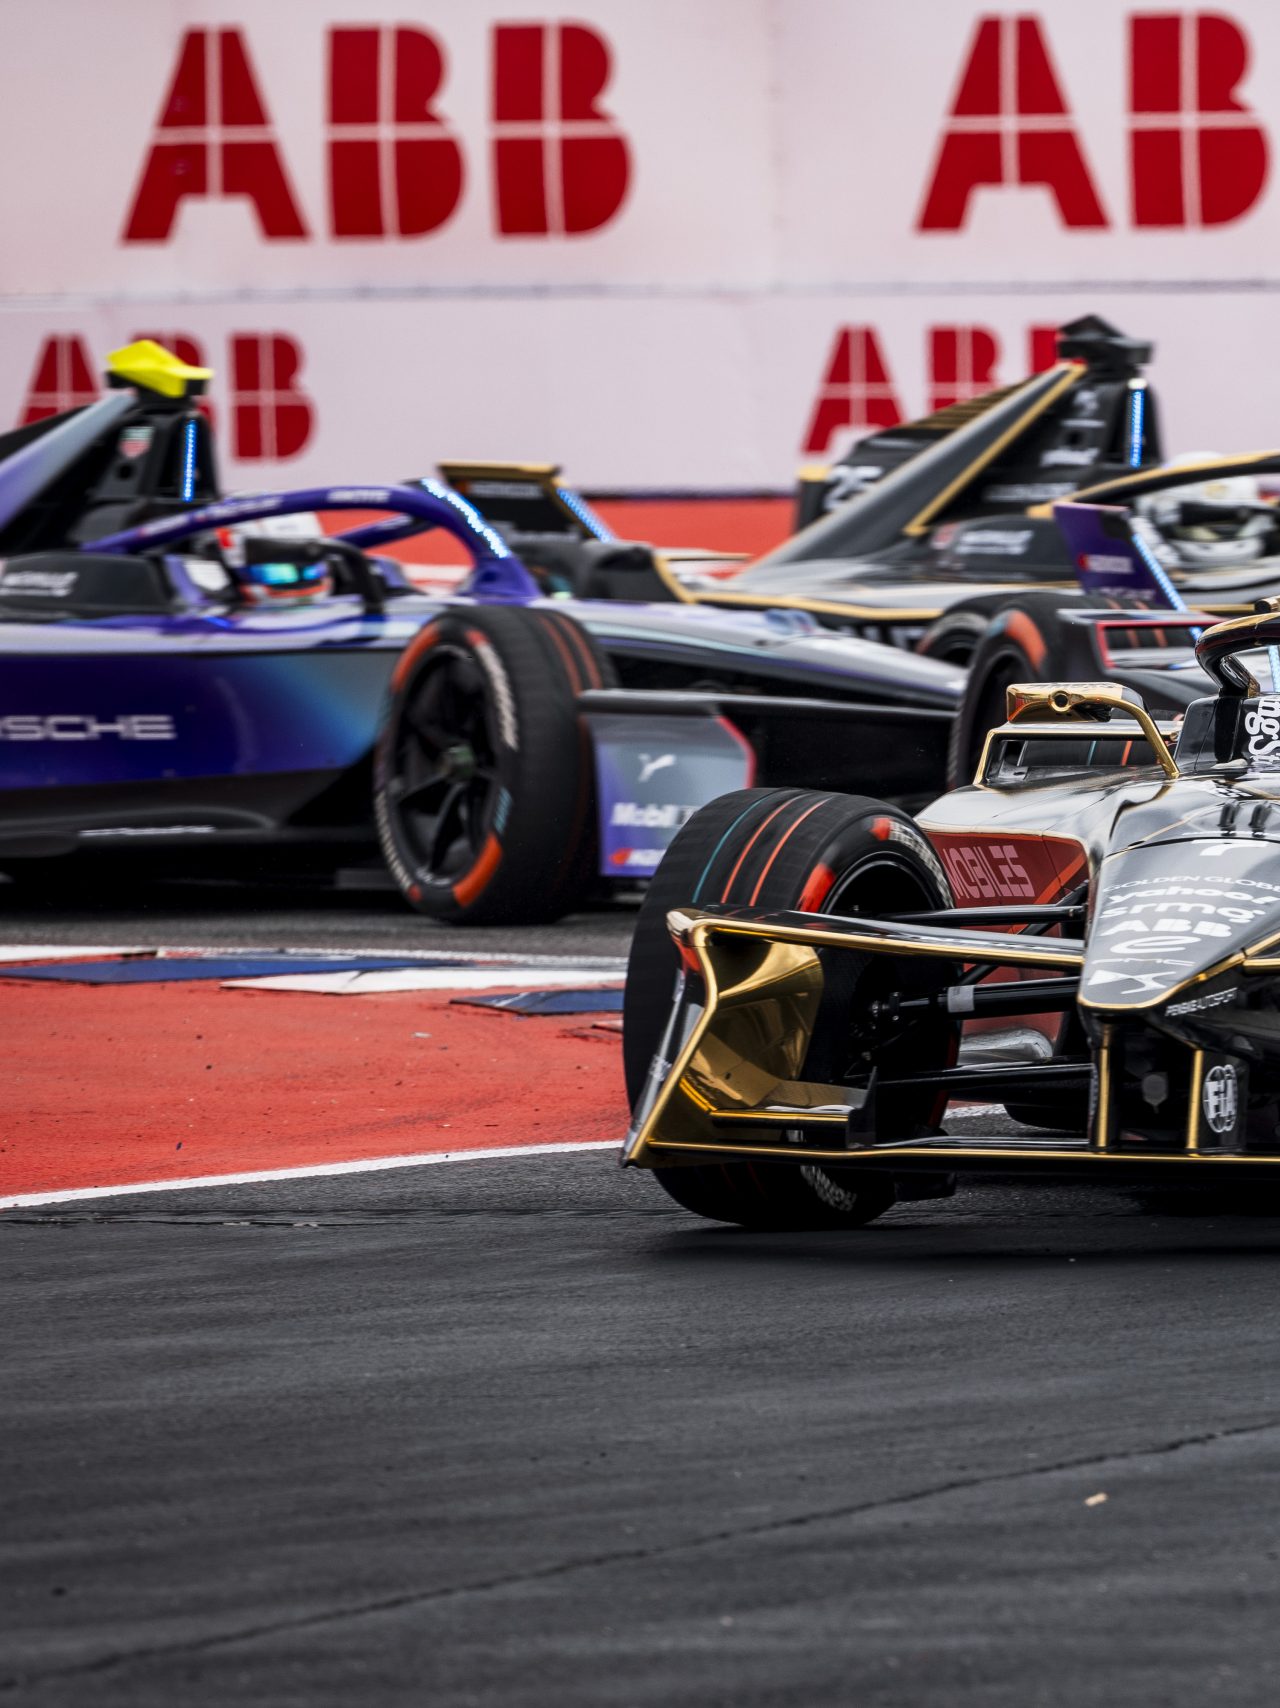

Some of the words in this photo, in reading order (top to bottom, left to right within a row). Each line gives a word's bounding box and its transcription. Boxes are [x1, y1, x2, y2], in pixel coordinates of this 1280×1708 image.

[120, 23, 635, 245] ABB
[803, 324, 1060, 455] AB
[1100, 918, 1232, 938] ABB
